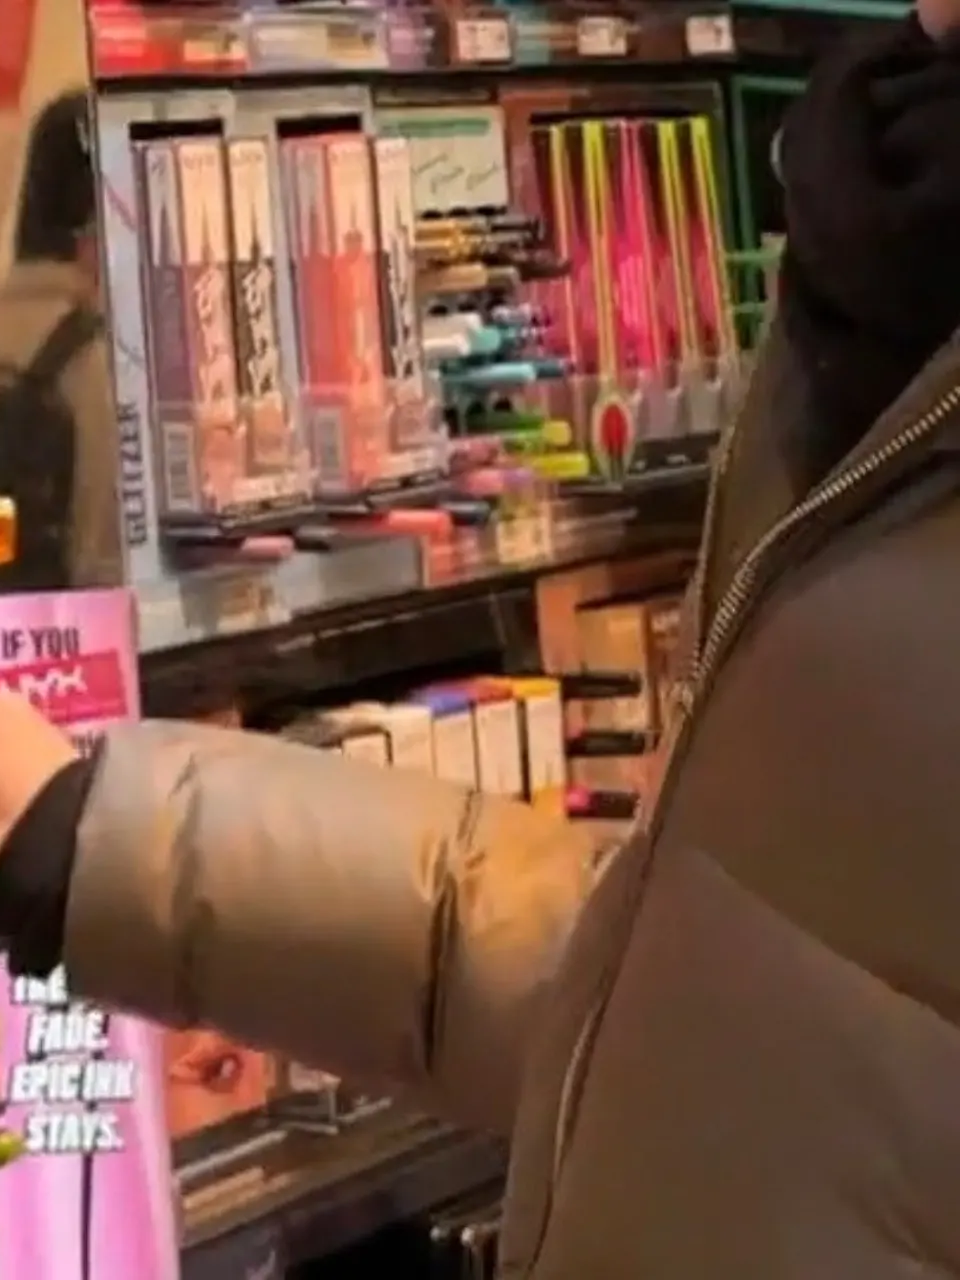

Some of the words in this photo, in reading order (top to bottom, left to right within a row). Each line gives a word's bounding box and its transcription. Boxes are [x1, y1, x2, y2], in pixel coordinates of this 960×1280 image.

[2, 627, 26, 659] IF
[30, 626, 80, 658] YOU
[26, 1009, 109, 1056] FADE.
[10, 1059, 84, 1104] EPIC
[84, 1056, 135, 1101] INK
[26, 1111, 125, 1151] STAYS.
